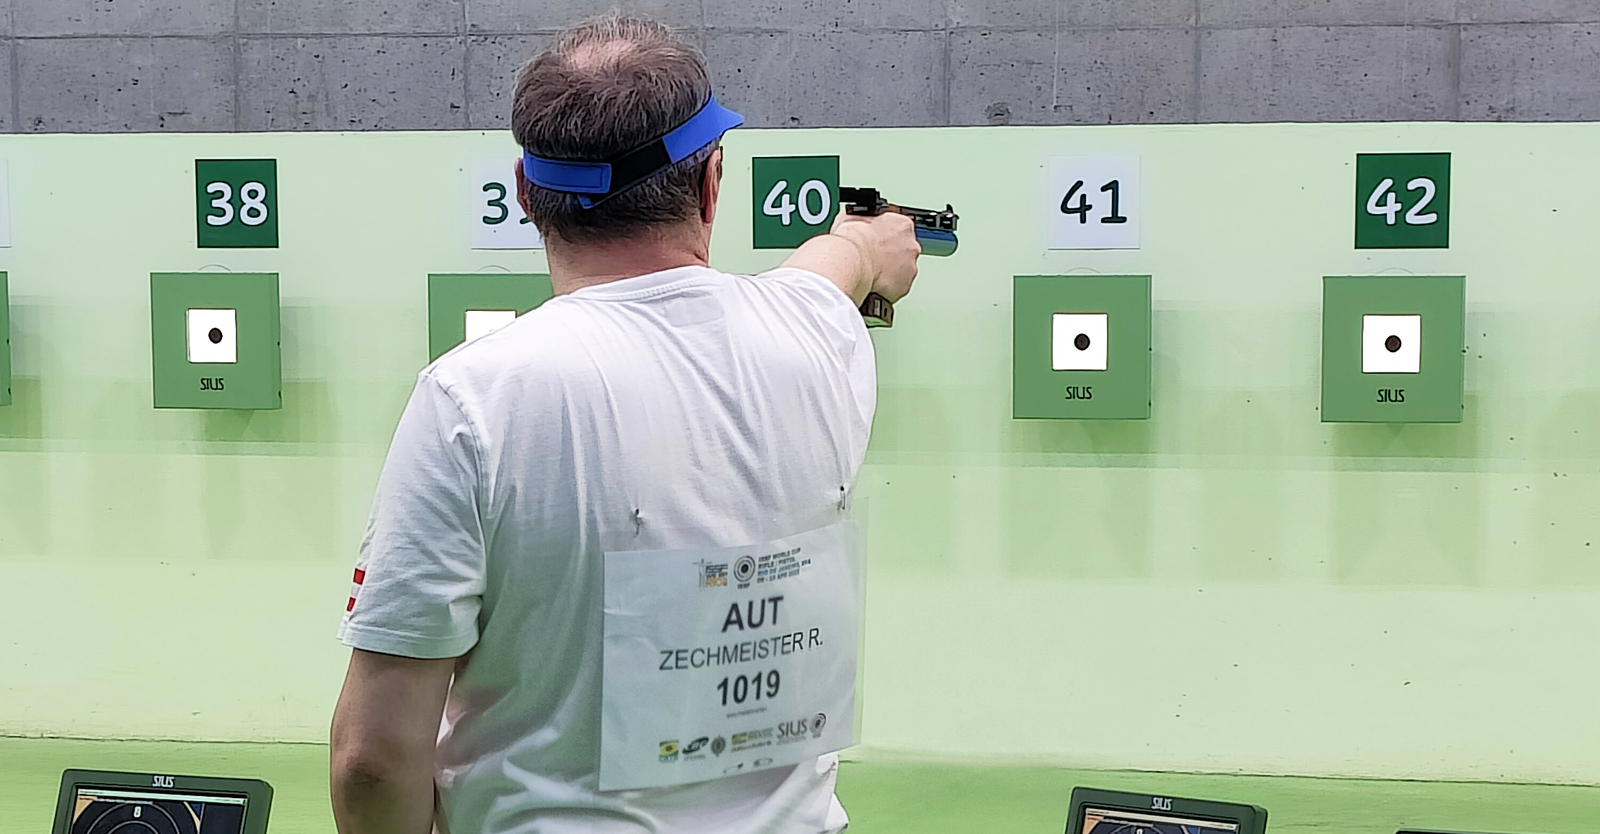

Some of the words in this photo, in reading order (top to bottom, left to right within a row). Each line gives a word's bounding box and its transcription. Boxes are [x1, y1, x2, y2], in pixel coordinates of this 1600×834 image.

[206, 181, 268, 226] 38
[482, 182, 531, 225] 3
[763, 180, 831, 225] 40
[1060, 180, 1128, 224] 41
[1366, 177, 1438, 225] 42
[200, 377, 225, 391] SIUS
[1065, 386, 1093, 400] SIUS
[1376, 389, 1405, 403] SIUS
[721, 595, 785, 633] AUT
[658, 631, 804, 672] ZECHMEISTER
[808, 627, 824, 650] R.
[716, 669, 781, 707] 1019
[777, 718, 808, 740] SIUS
[152, 775, 175, 788] SIUS
[133, 806, 142, 818] 8
[1151, 797, 1173, 811] SIUS
